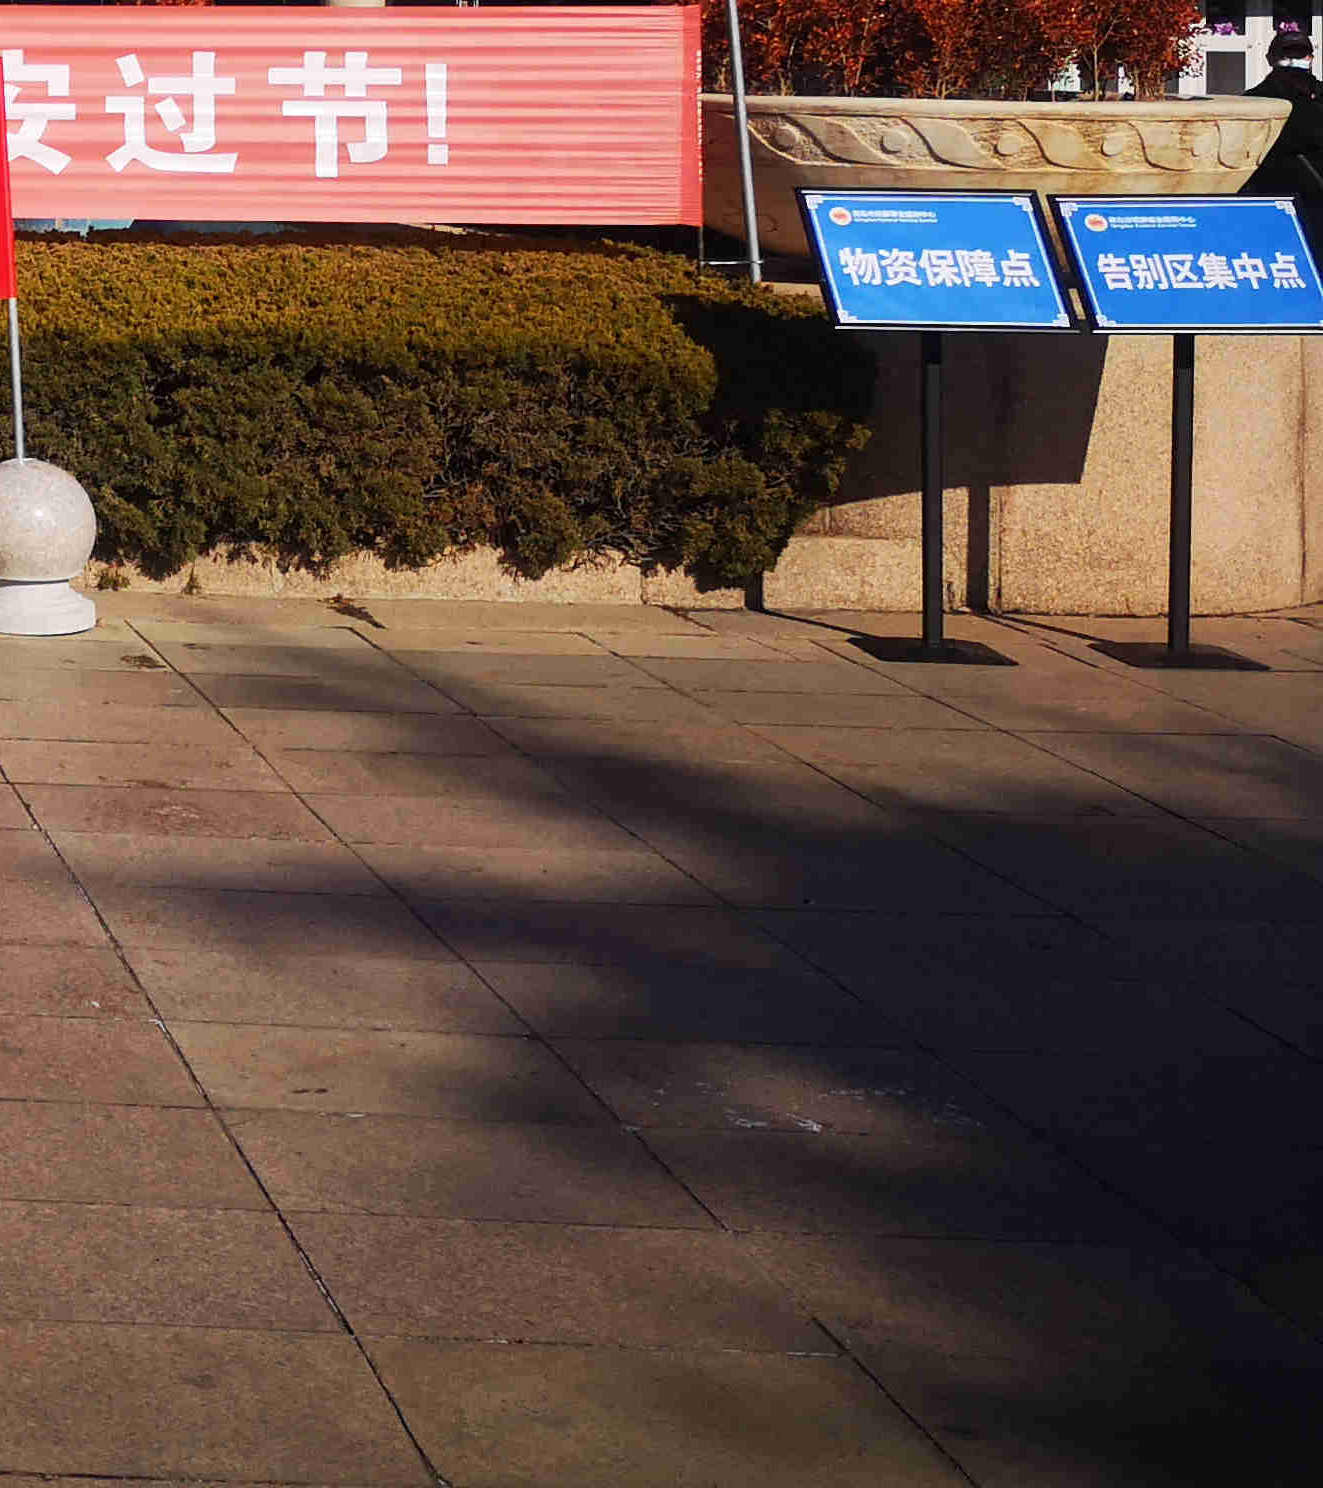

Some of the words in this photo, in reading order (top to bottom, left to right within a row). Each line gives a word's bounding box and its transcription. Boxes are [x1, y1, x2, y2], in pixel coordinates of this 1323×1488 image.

[838, 247, 1041, 288] 物资保障点
[1097, 252, 1307, 290] 告别区集中点
